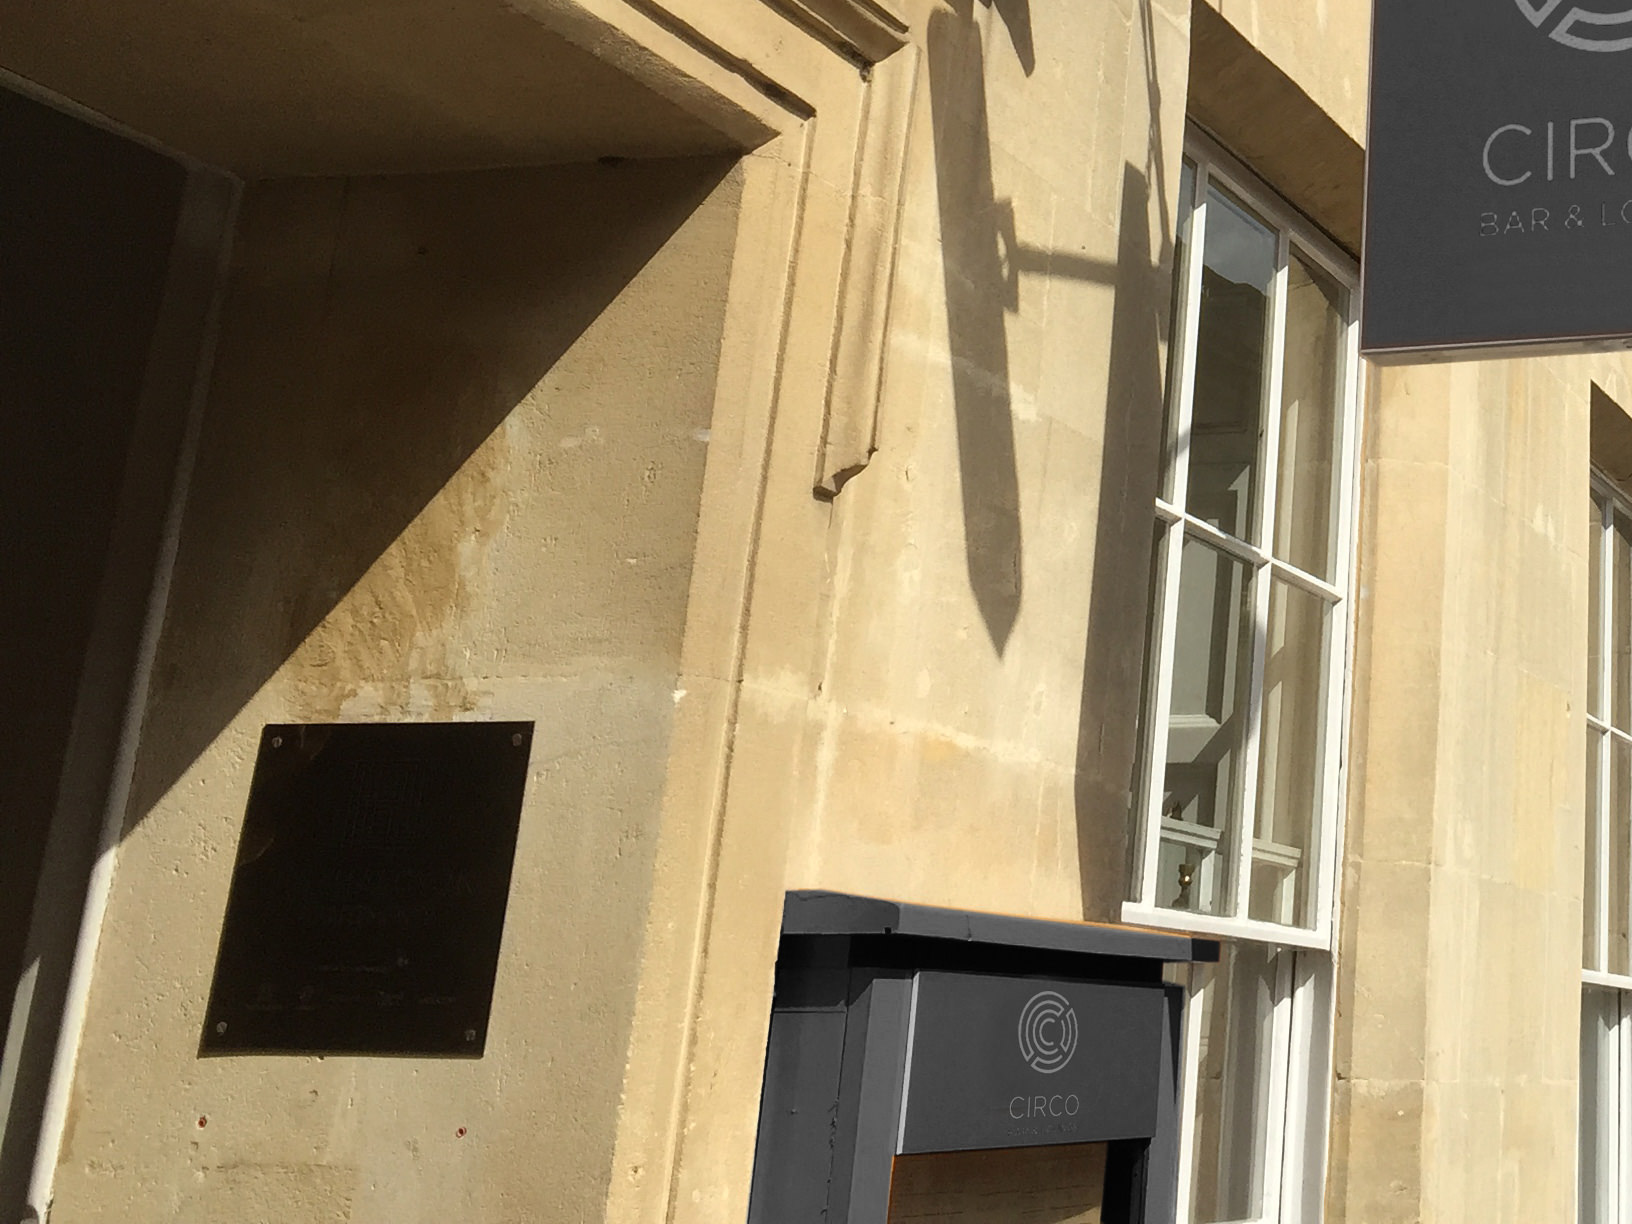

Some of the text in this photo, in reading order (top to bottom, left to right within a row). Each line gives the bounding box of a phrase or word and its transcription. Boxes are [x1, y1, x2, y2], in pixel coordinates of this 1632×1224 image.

[1479, 207, 1550, 237] BAR
[1564, 204, 1585, 229] &
[1008, 1094, 1080, 1120] CIRCO
